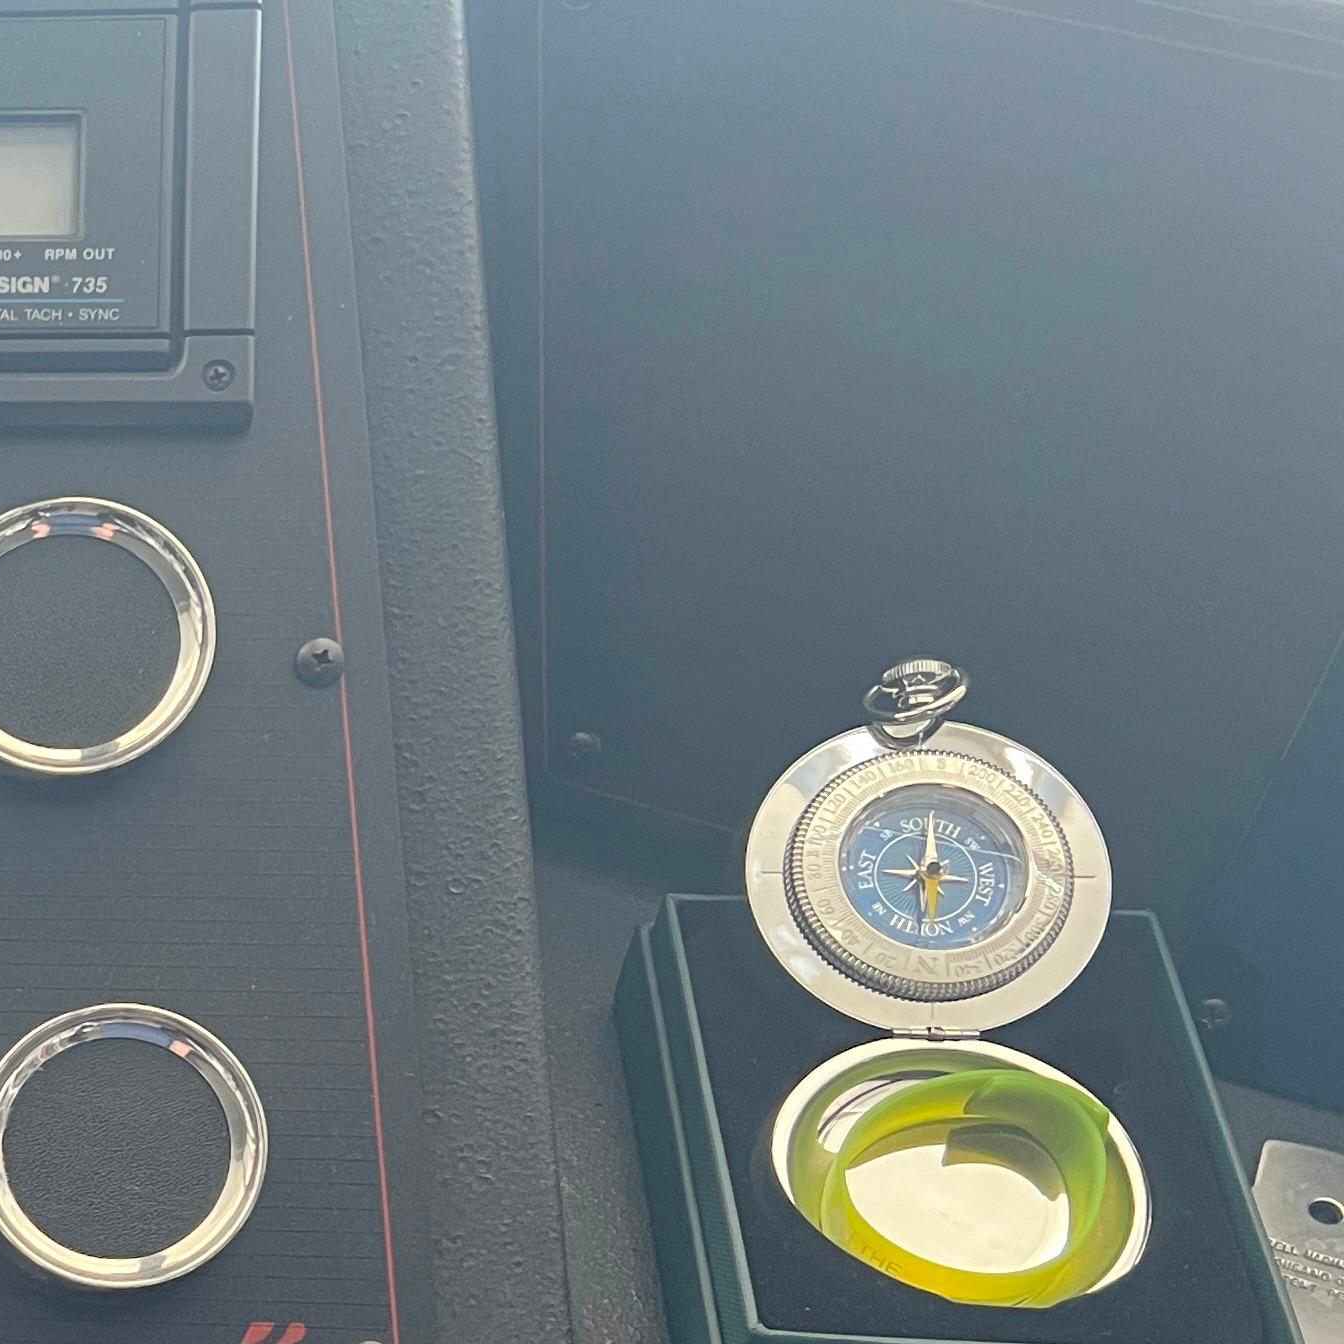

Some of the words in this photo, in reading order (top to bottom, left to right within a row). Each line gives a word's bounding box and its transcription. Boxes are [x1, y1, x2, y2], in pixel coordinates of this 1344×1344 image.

[44, 248, 77, 261] RPM
[83, 247, 116, 261] OUT
[70, 276, 109, 294] 735
[24, 308, 62, 321] TACH
[78, 308, 120, 321] SYNC
[858, 849, 877, 890] EAST
[975, 861, 996, 907] WEST
